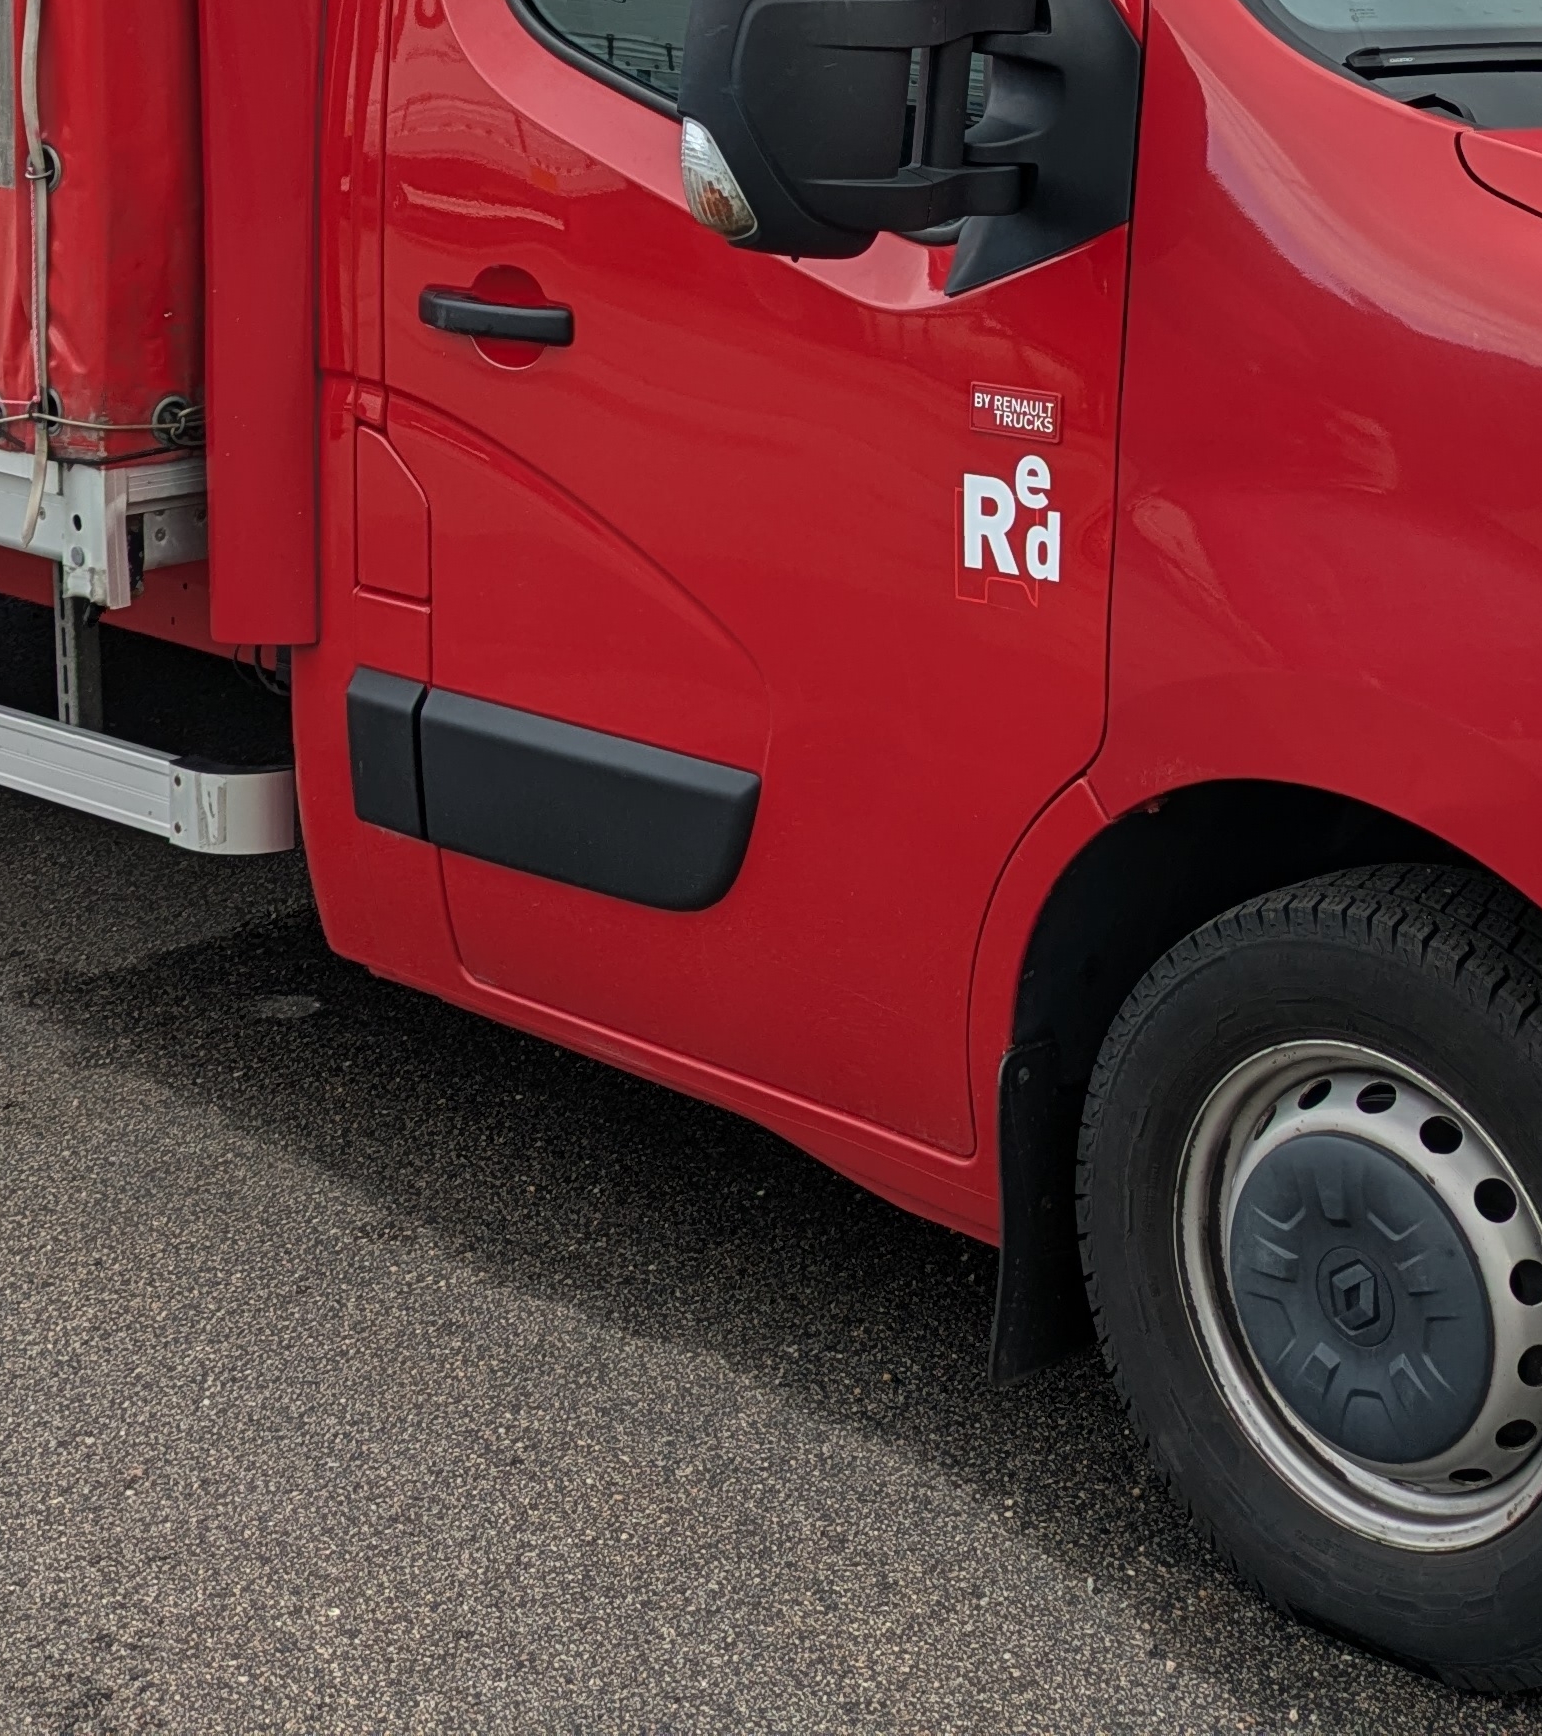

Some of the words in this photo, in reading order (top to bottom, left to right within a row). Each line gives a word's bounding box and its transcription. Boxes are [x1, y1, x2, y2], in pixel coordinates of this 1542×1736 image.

[974, 392, 991, 409] BY
[994, 396, 1054, 418] RENAULT
[993, 410, 1054, 433] TRUCKS
[963, 454, 1061, 583] Red
